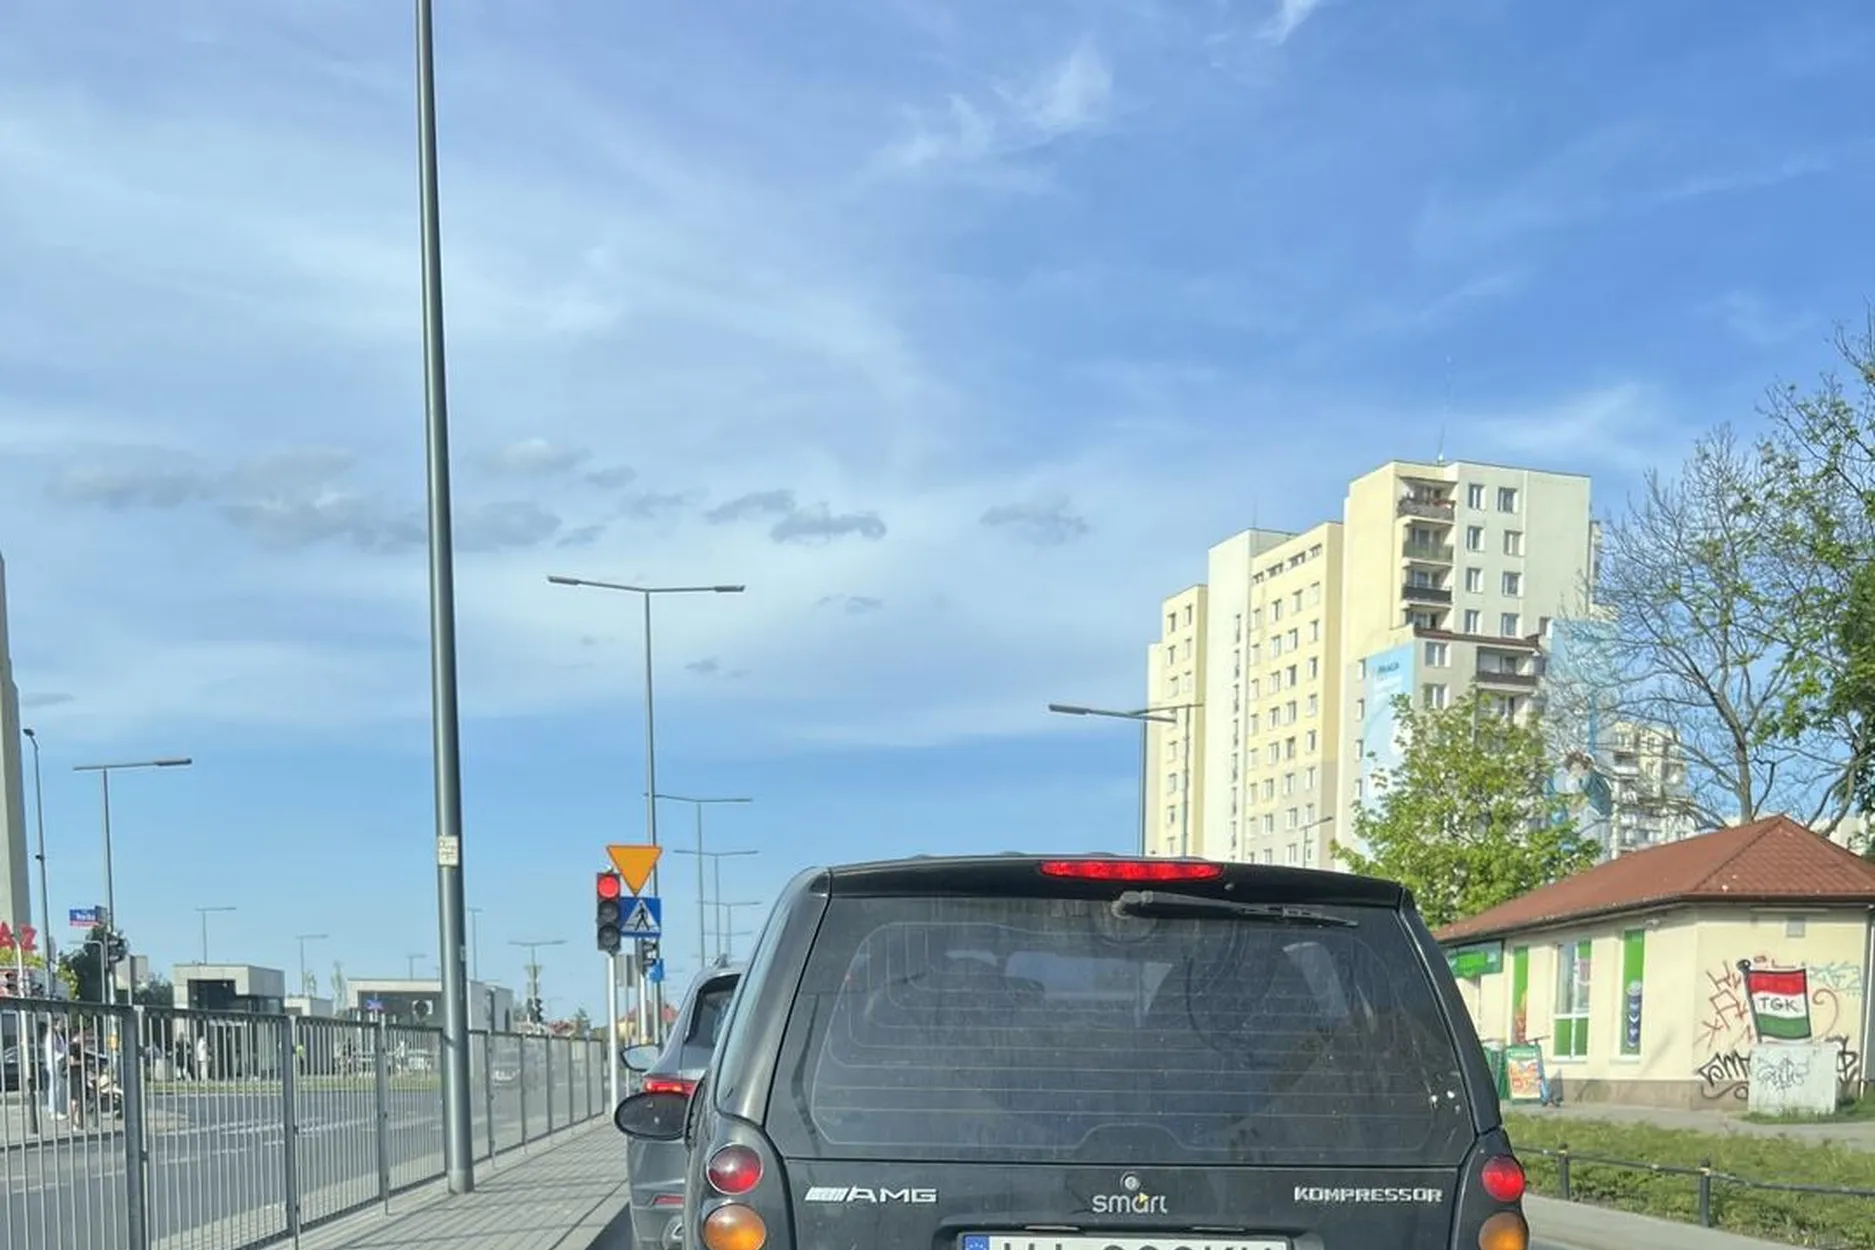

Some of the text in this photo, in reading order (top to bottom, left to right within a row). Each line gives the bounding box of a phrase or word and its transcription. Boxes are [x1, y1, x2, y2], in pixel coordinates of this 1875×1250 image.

[1758, 996, 1801, 1013] TGK
[846, 1186, 938, 1203] AMG
[1092, 1192, 1168, 1213] smart
[1294, 1186, 1444, 1203] KOMPRESSOR
